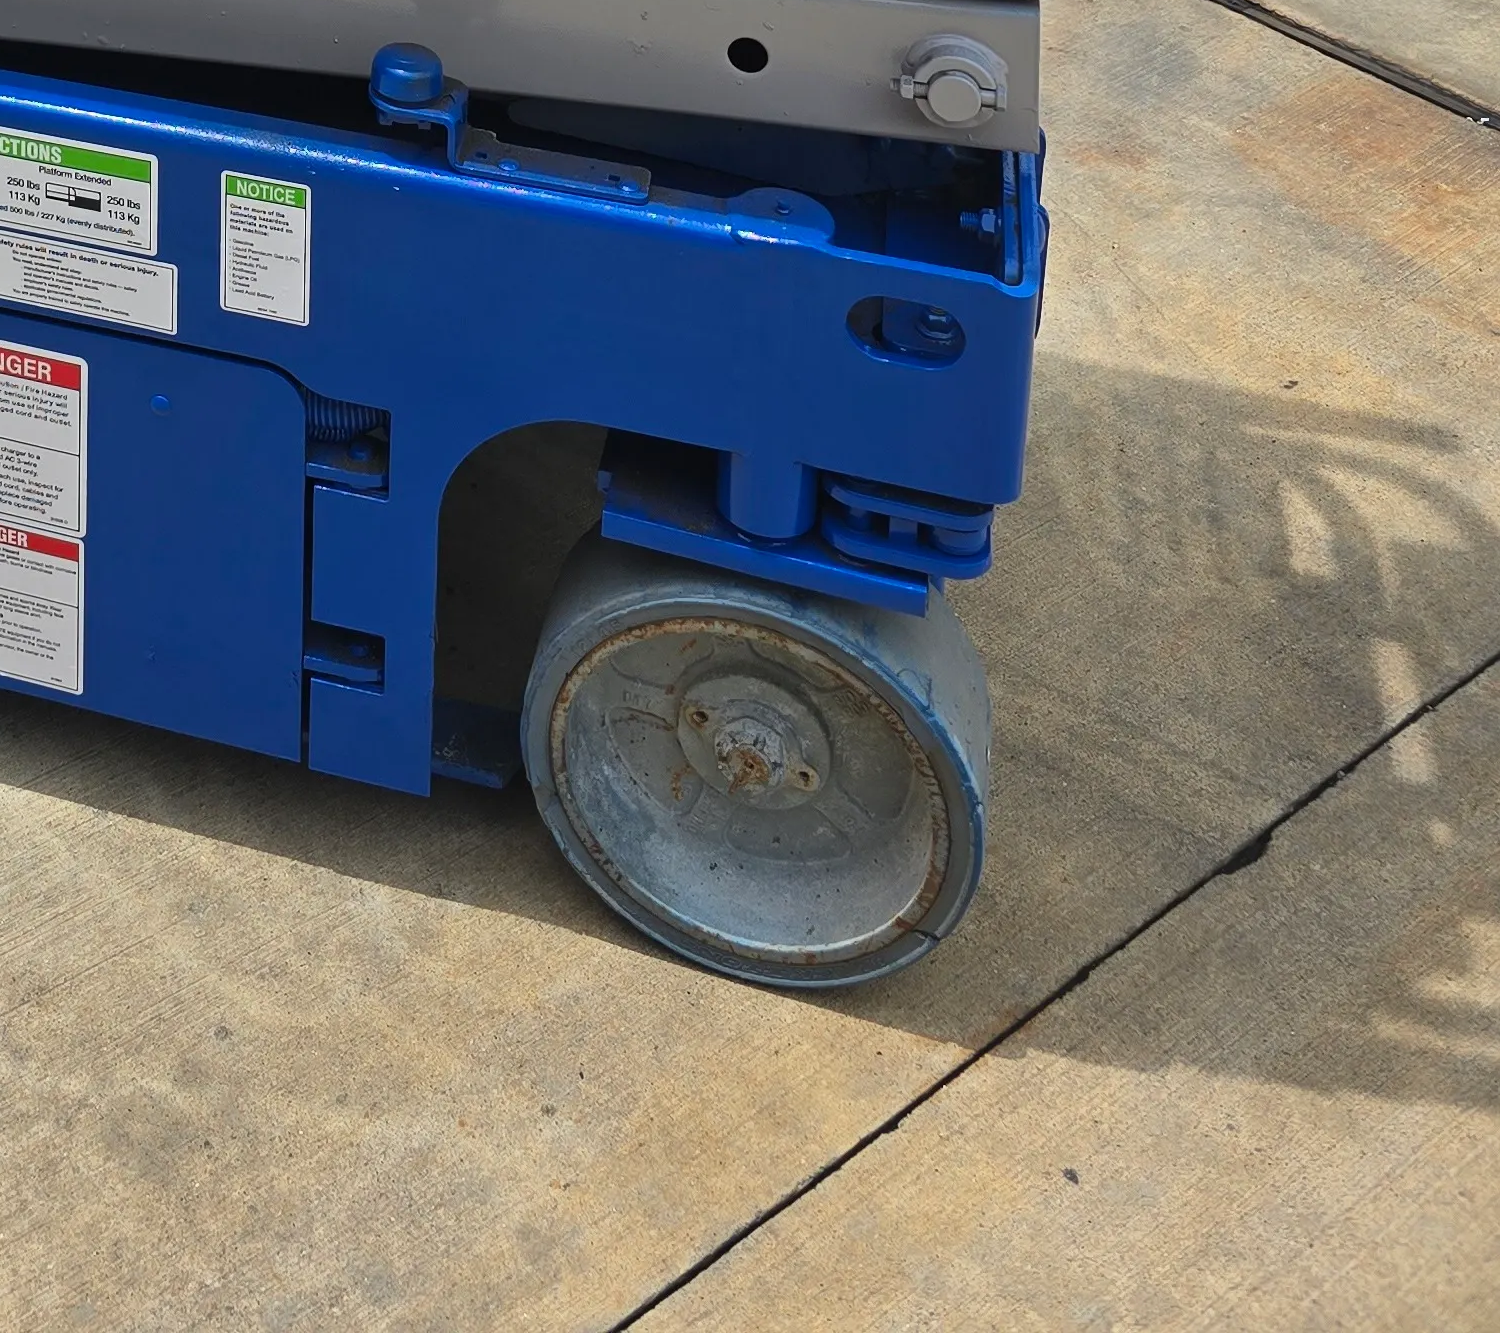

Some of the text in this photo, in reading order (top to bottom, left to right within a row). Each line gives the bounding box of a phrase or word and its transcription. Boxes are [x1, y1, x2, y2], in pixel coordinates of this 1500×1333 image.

[39, 166, 111, 186] Platform Extended
[7, 177, 40, 190] 250 lbs
[9, 191, 40, 205] 113 Kg
[236, 179, 295, 204] NOTICE
[107, 196, 140, 209] 250 lbs
[41, 212, 54, 220] 227
[108, 210, 139, 225] 113 Kg
[5, 391, 30, 400] serious
[33, 394, 53, 406] injury
[25, 385, 39, 393] Fire
[42, 390, 67, 400] Hazard
[16, 409, 31, 417] cord
[36, 406, 68, 417] improper
[1, 446, 26, 456] charger
